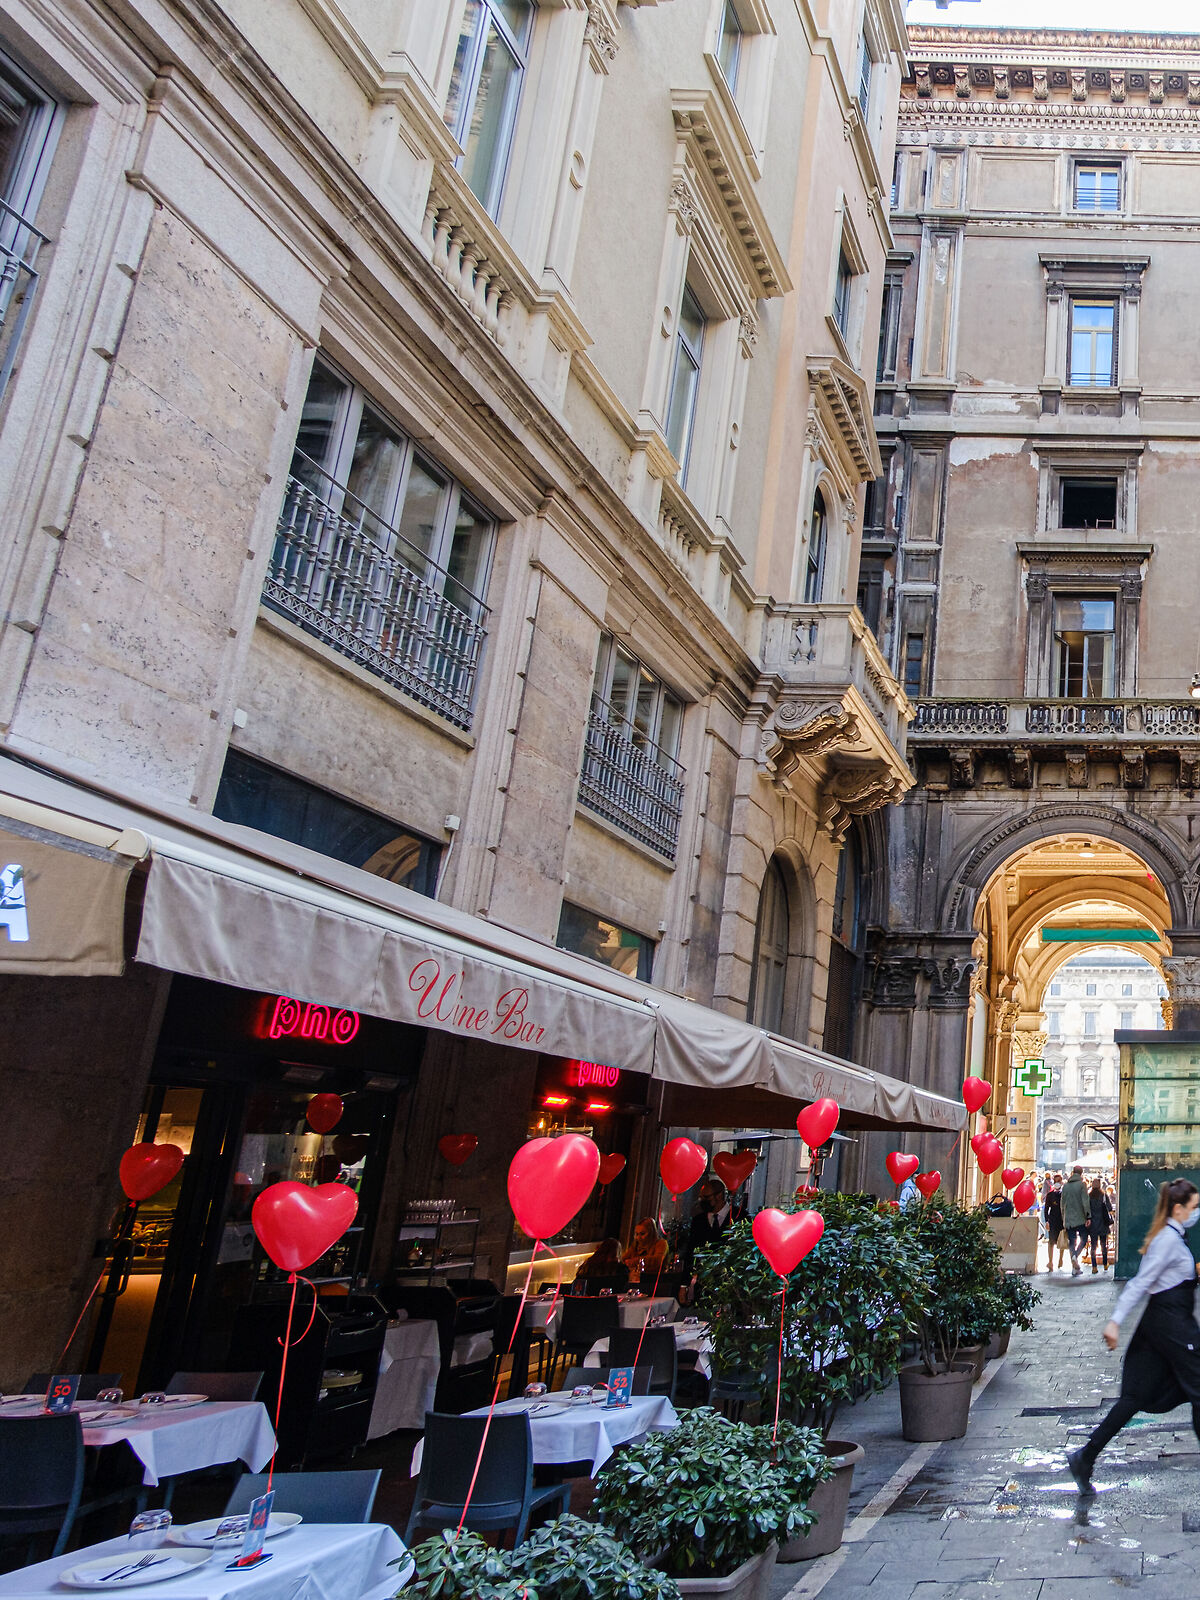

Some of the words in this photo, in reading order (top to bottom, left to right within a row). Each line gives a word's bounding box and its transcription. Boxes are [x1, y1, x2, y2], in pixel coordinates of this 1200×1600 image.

[408, 958, 489, 1031] Wine
[490, 987, 546, 1044] Bar
[612, 1377, 628, 1390] 52
[52, 1384, 72, 1398] 50
